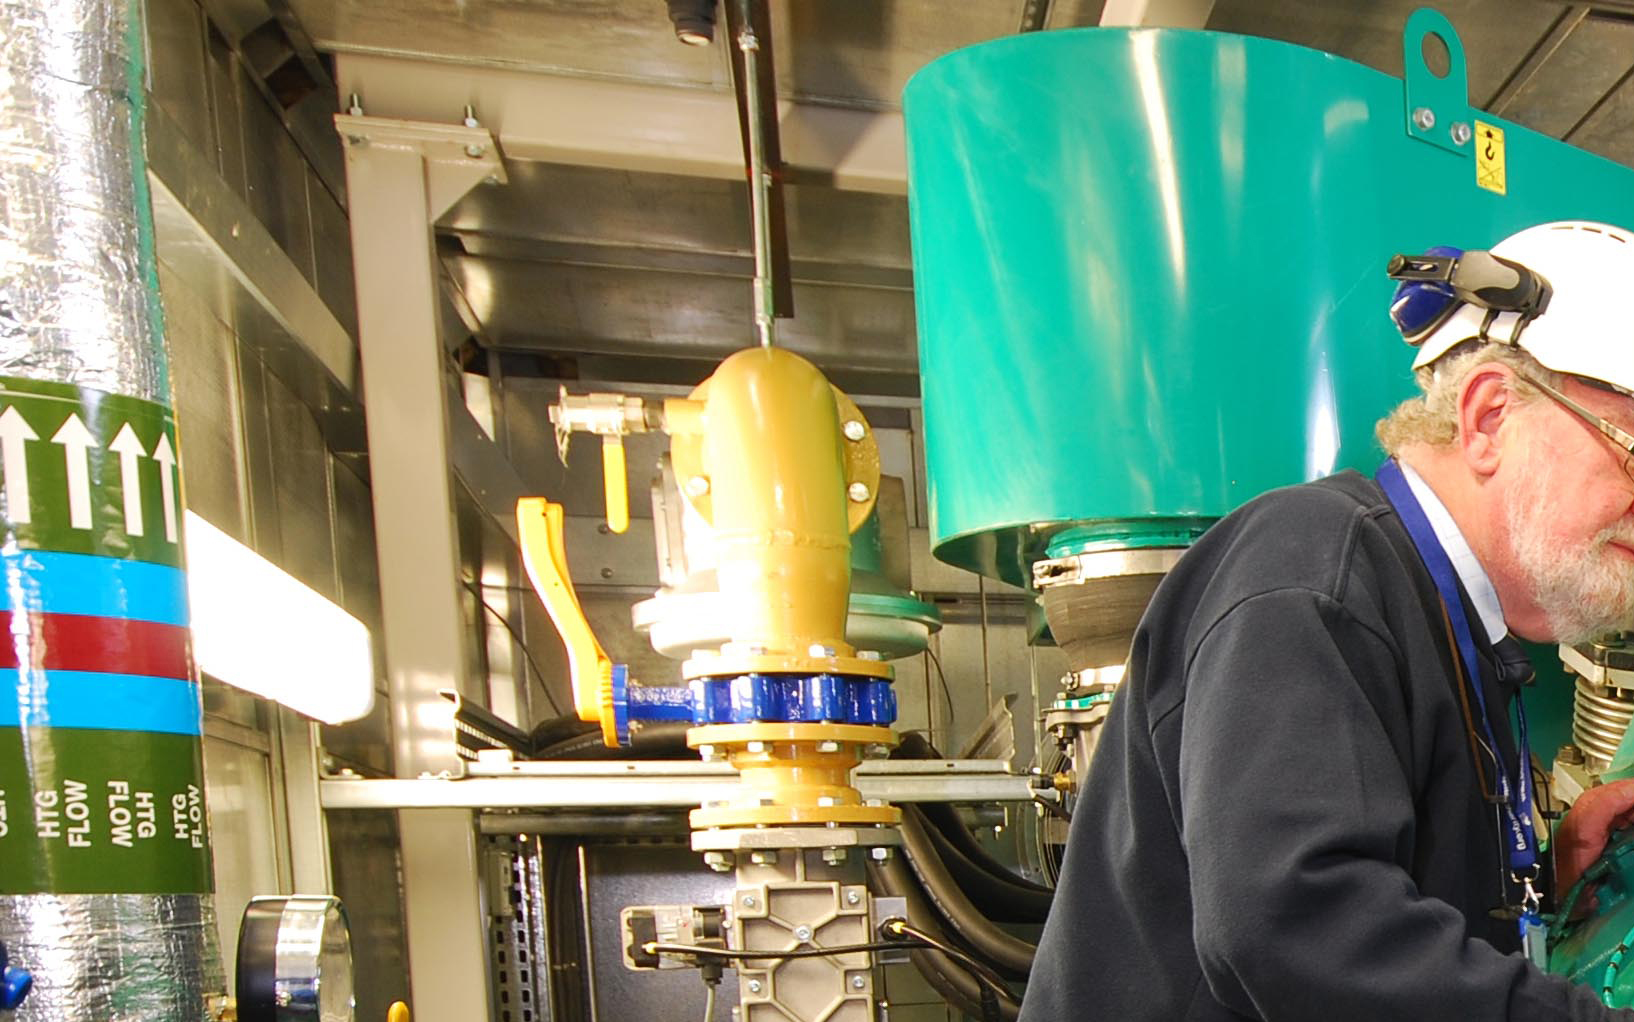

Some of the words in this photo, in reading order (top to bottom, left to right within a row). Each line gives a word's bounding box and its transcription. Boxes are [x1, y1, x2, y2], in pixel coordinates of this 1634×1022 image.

[34, 790, 61, 838] HTG
[63, 779, 92, 848] FLOW
[107, 780, 134, 848] FLOW
[135, 791, 157, 839] HTG
[171, 793, 189, 839] HTG
[187, 784, 204, 849] FLOW
